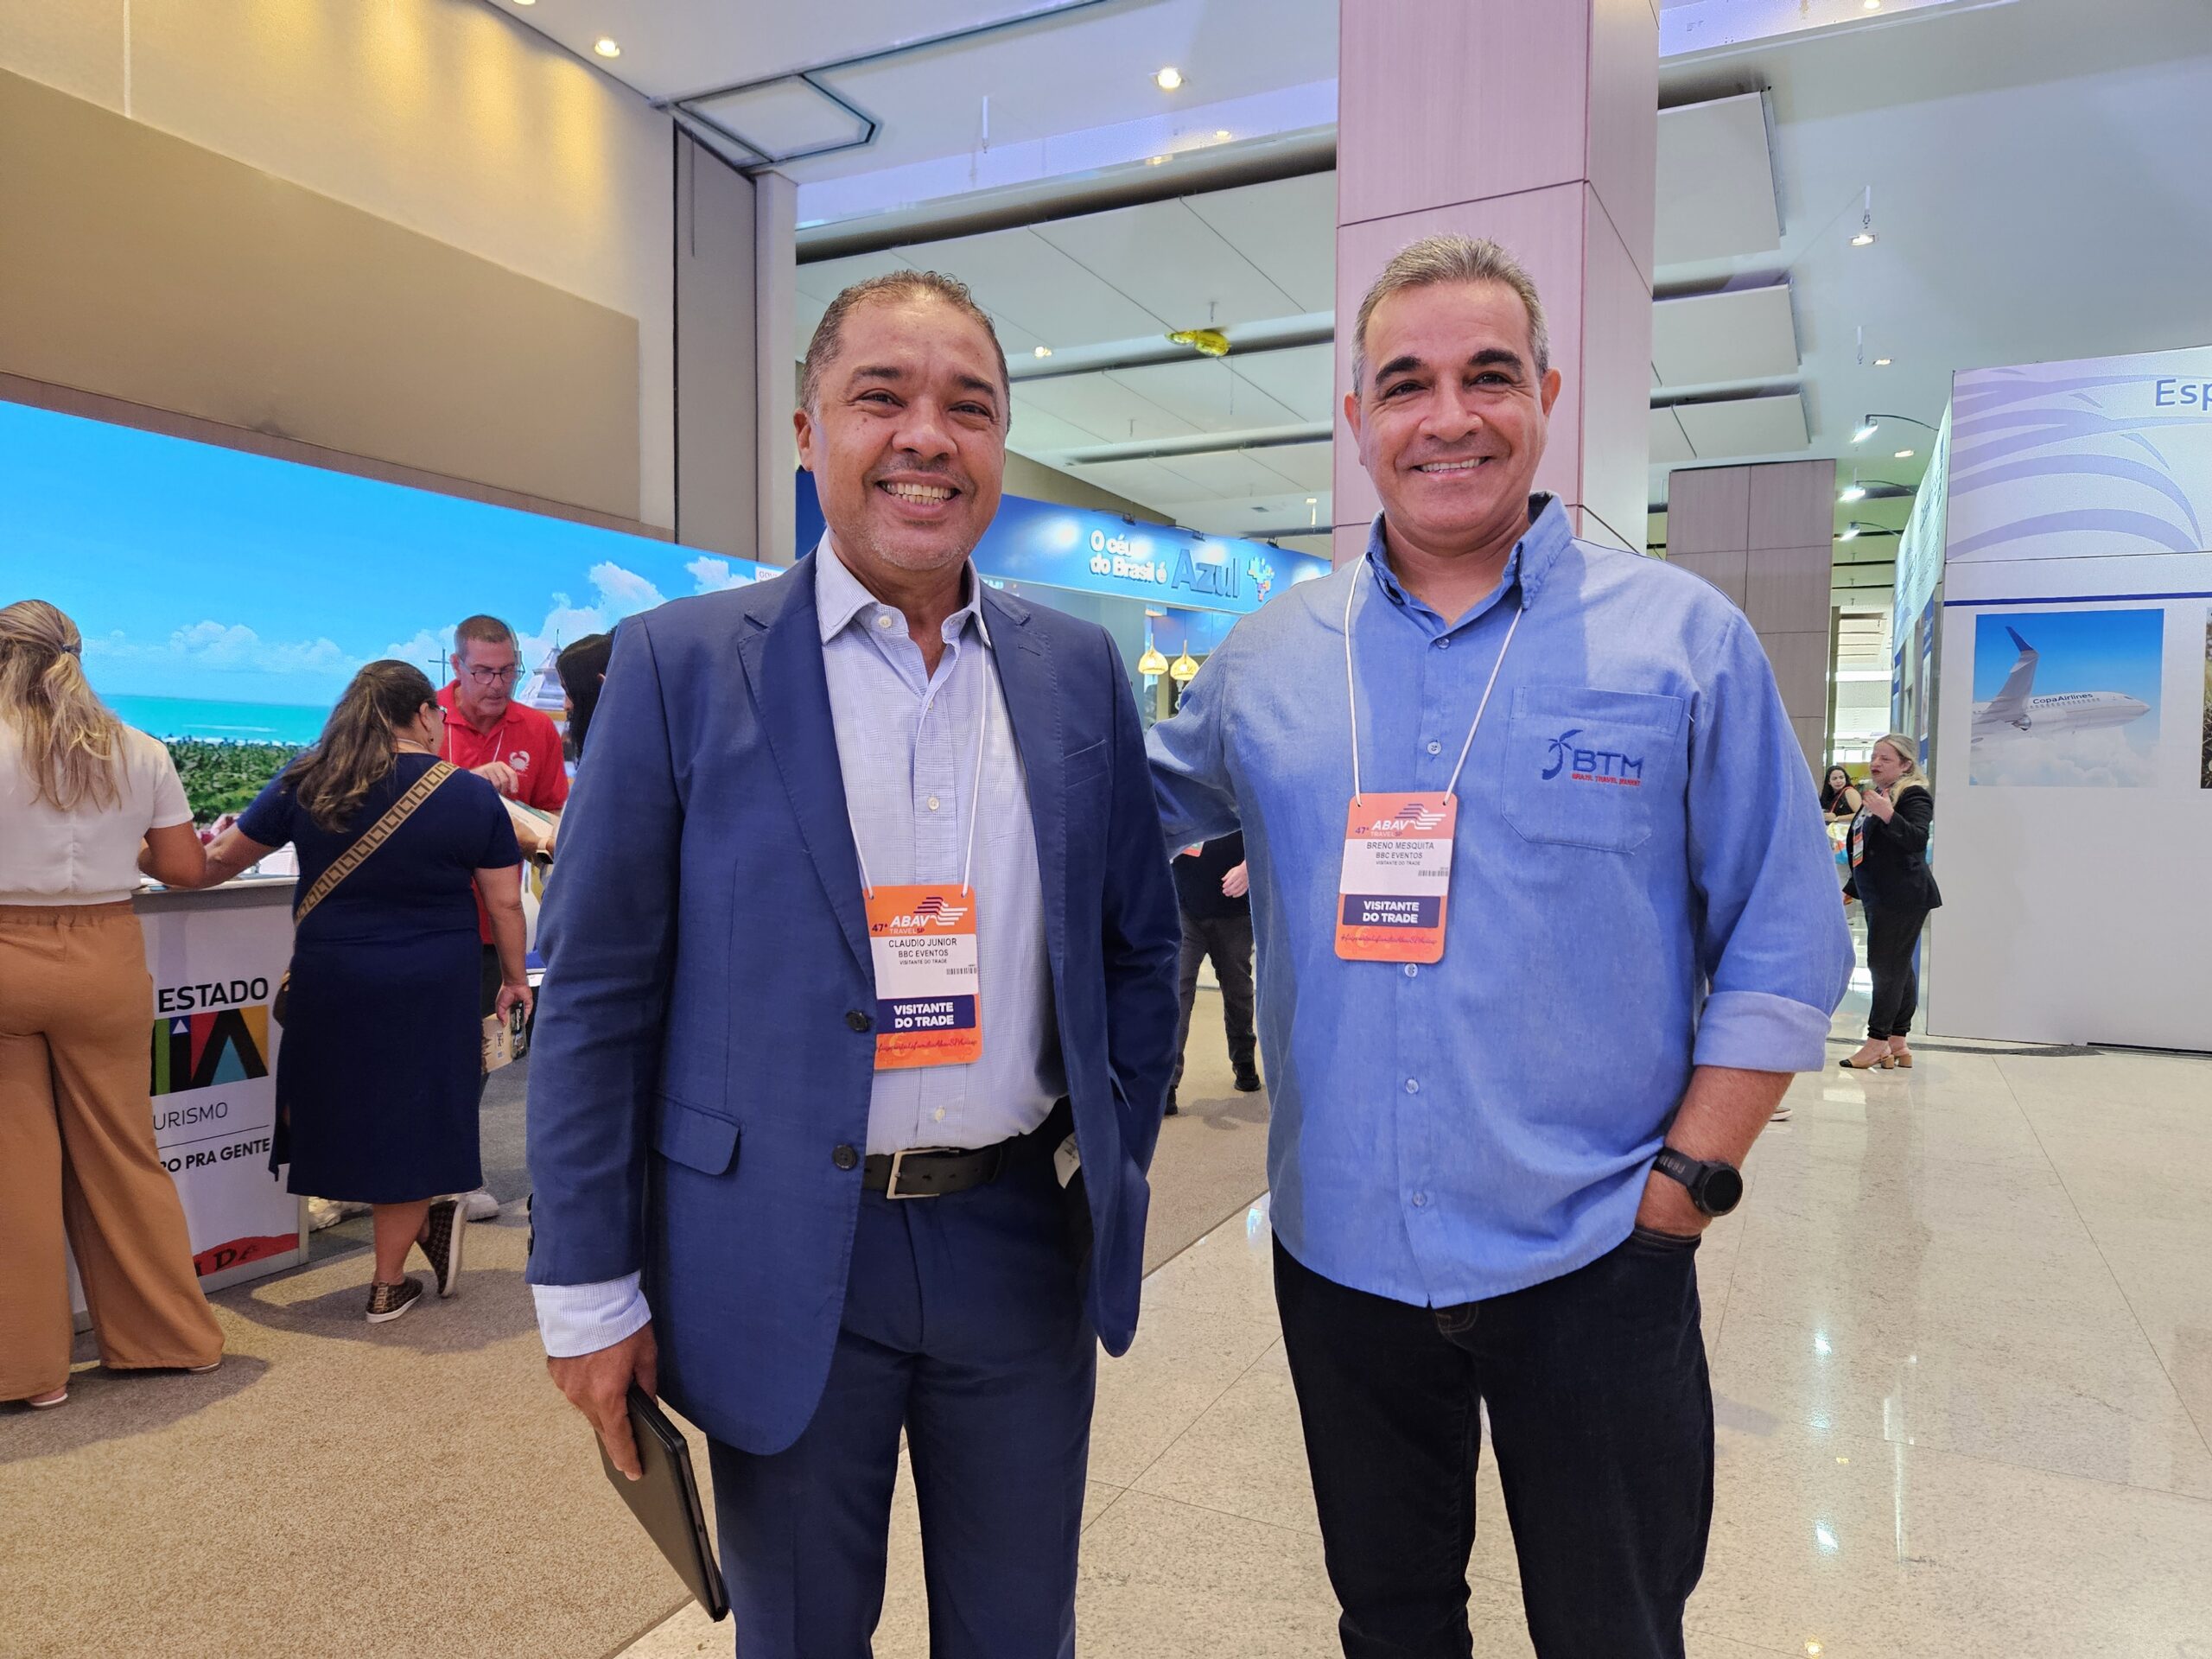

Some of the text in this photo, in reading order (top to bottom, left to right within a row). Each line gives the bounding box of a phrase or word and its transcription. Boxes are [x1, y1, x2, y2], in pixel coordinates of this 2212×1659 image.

[1090, 530, 1105, 552] O
[1090, 553, 1167, 585] do Brasil é
[1171, 549, 1240, 598] Azul
[1573, 749, 1644, 779] BTM
[1370, 820, 1408, 830] ABAV
[1395, 842, 1434, 850] MESQUITA
[1363, 900, 1420, 912] VISITANTE
[890, 914, 930, 927] ABAV
[1363, 912, 1418, 924] DO TRADE
[888, 938, 957, 948] CLAUDIO JUNIOR
[915, 949, 949, 957] EVENTOS
[158, 977, 269, 1013] ESTADO
[893, 1001, 954, 1015] VISITANTE
[894, 1014, 954, 1028] DO TRADE
[153, 1102, 228, 1130] URISMO
[186, 1150, 217, 1169] PRA
[220, 1137, 270, 1160] GENTE
